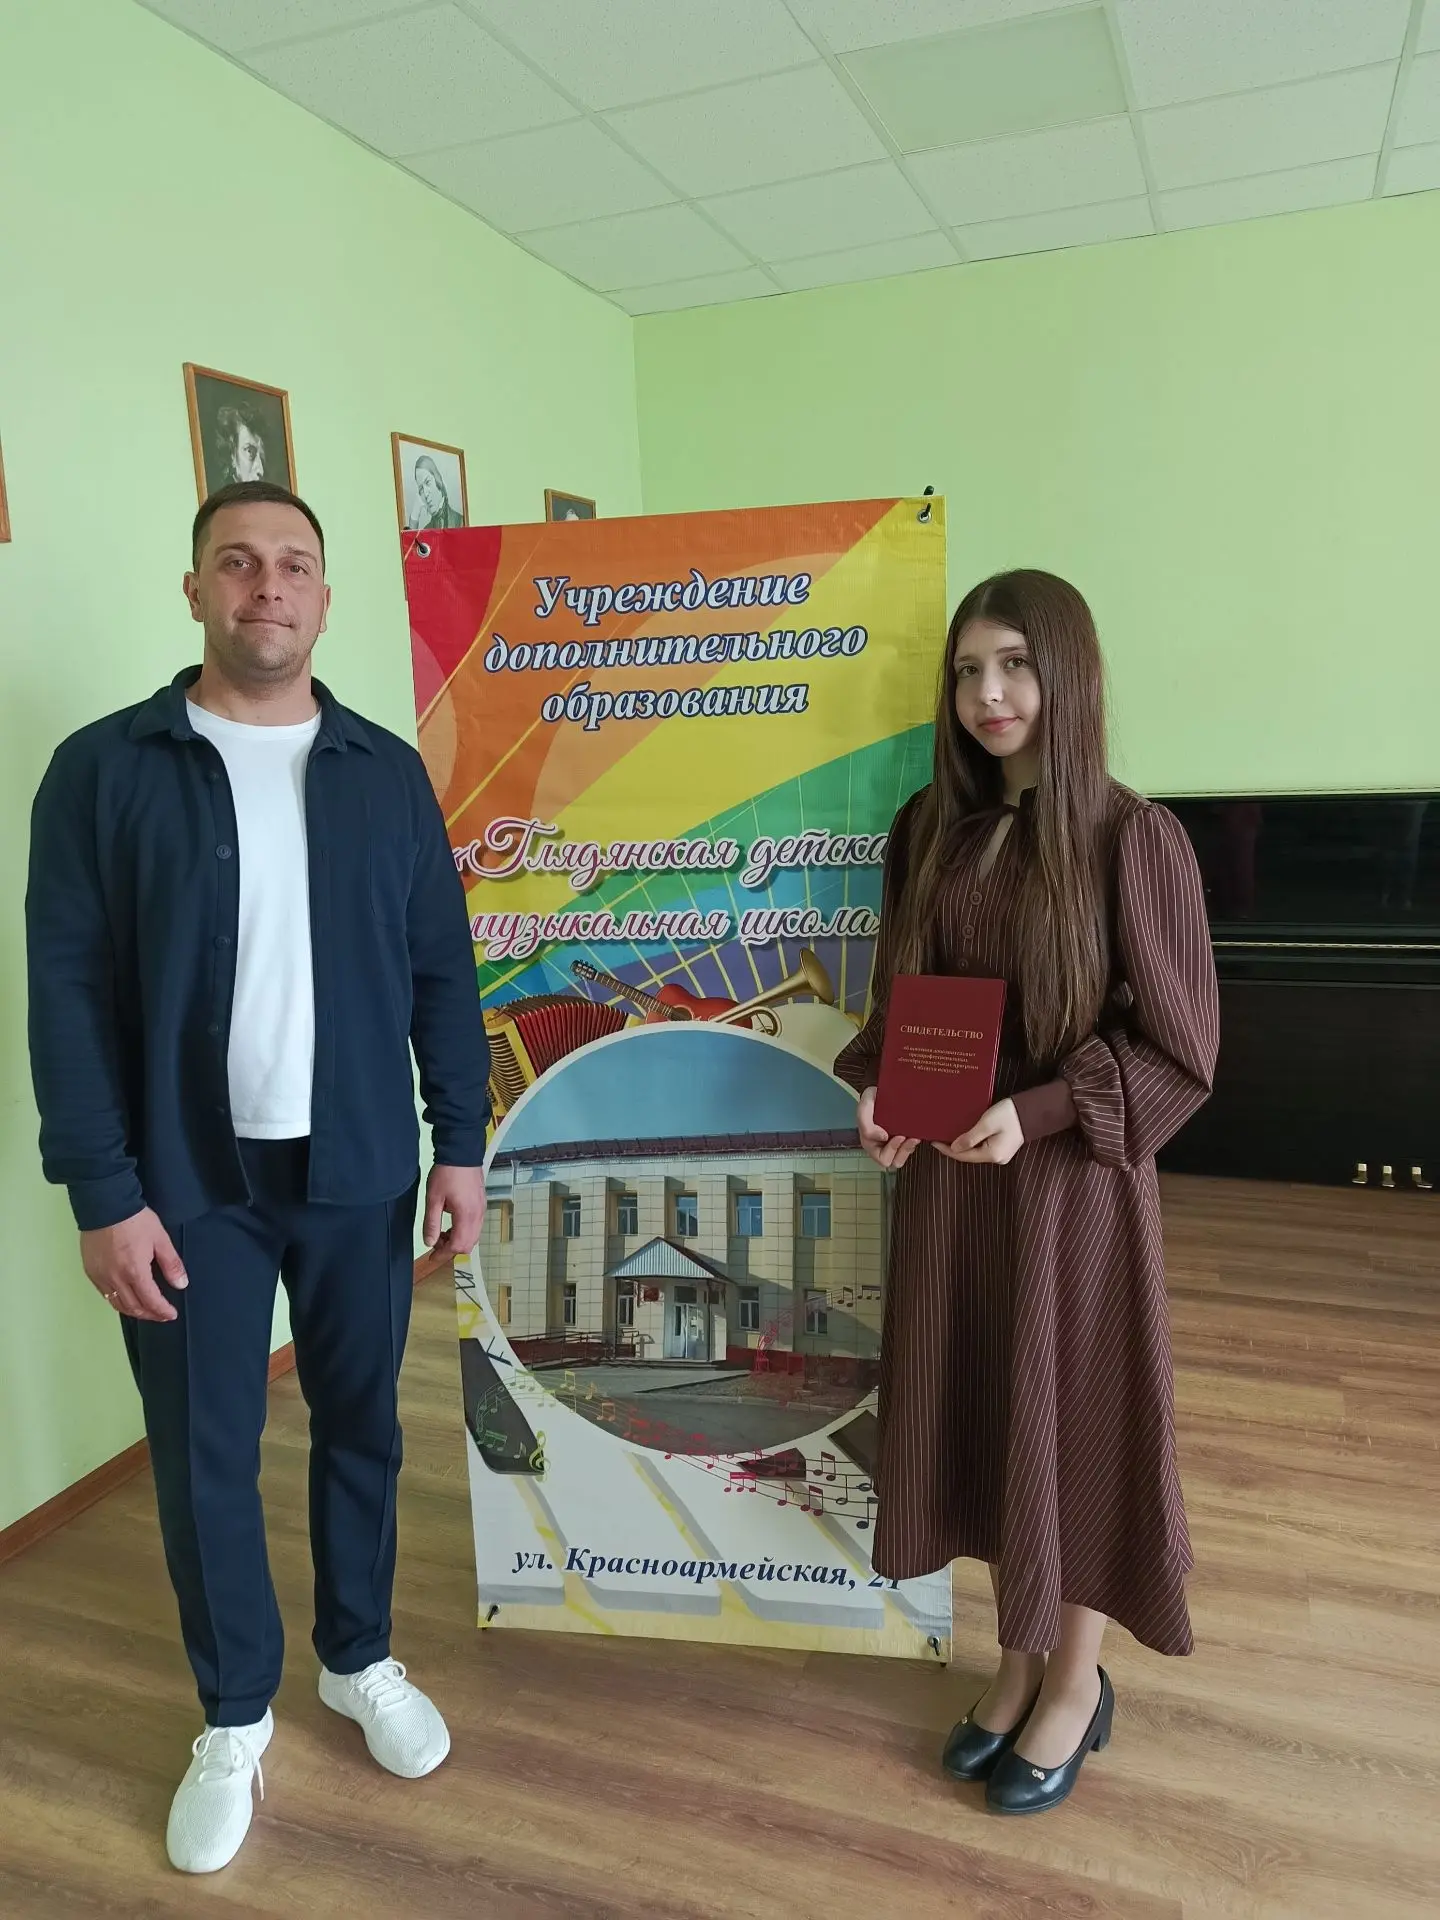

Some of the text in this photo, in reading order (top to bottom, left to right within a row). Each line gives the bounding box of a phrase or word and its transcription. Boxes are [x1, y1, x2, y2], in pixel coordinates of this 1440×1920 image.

[533, 568, 812, 626] Учреждение
[484, 625, 868, 673] дополнительного
[541, 681, 810, 731] образования
[741, 829, 886, 887] детска
[470, 909, 730, 960] музыкальная
[900, 1024, 984, 1040] СВИДЕТЕЛЬСТВО
[512, 1551, 553, 1573] ул.
[565, 1547, 856, 1591] Красноармейская,
